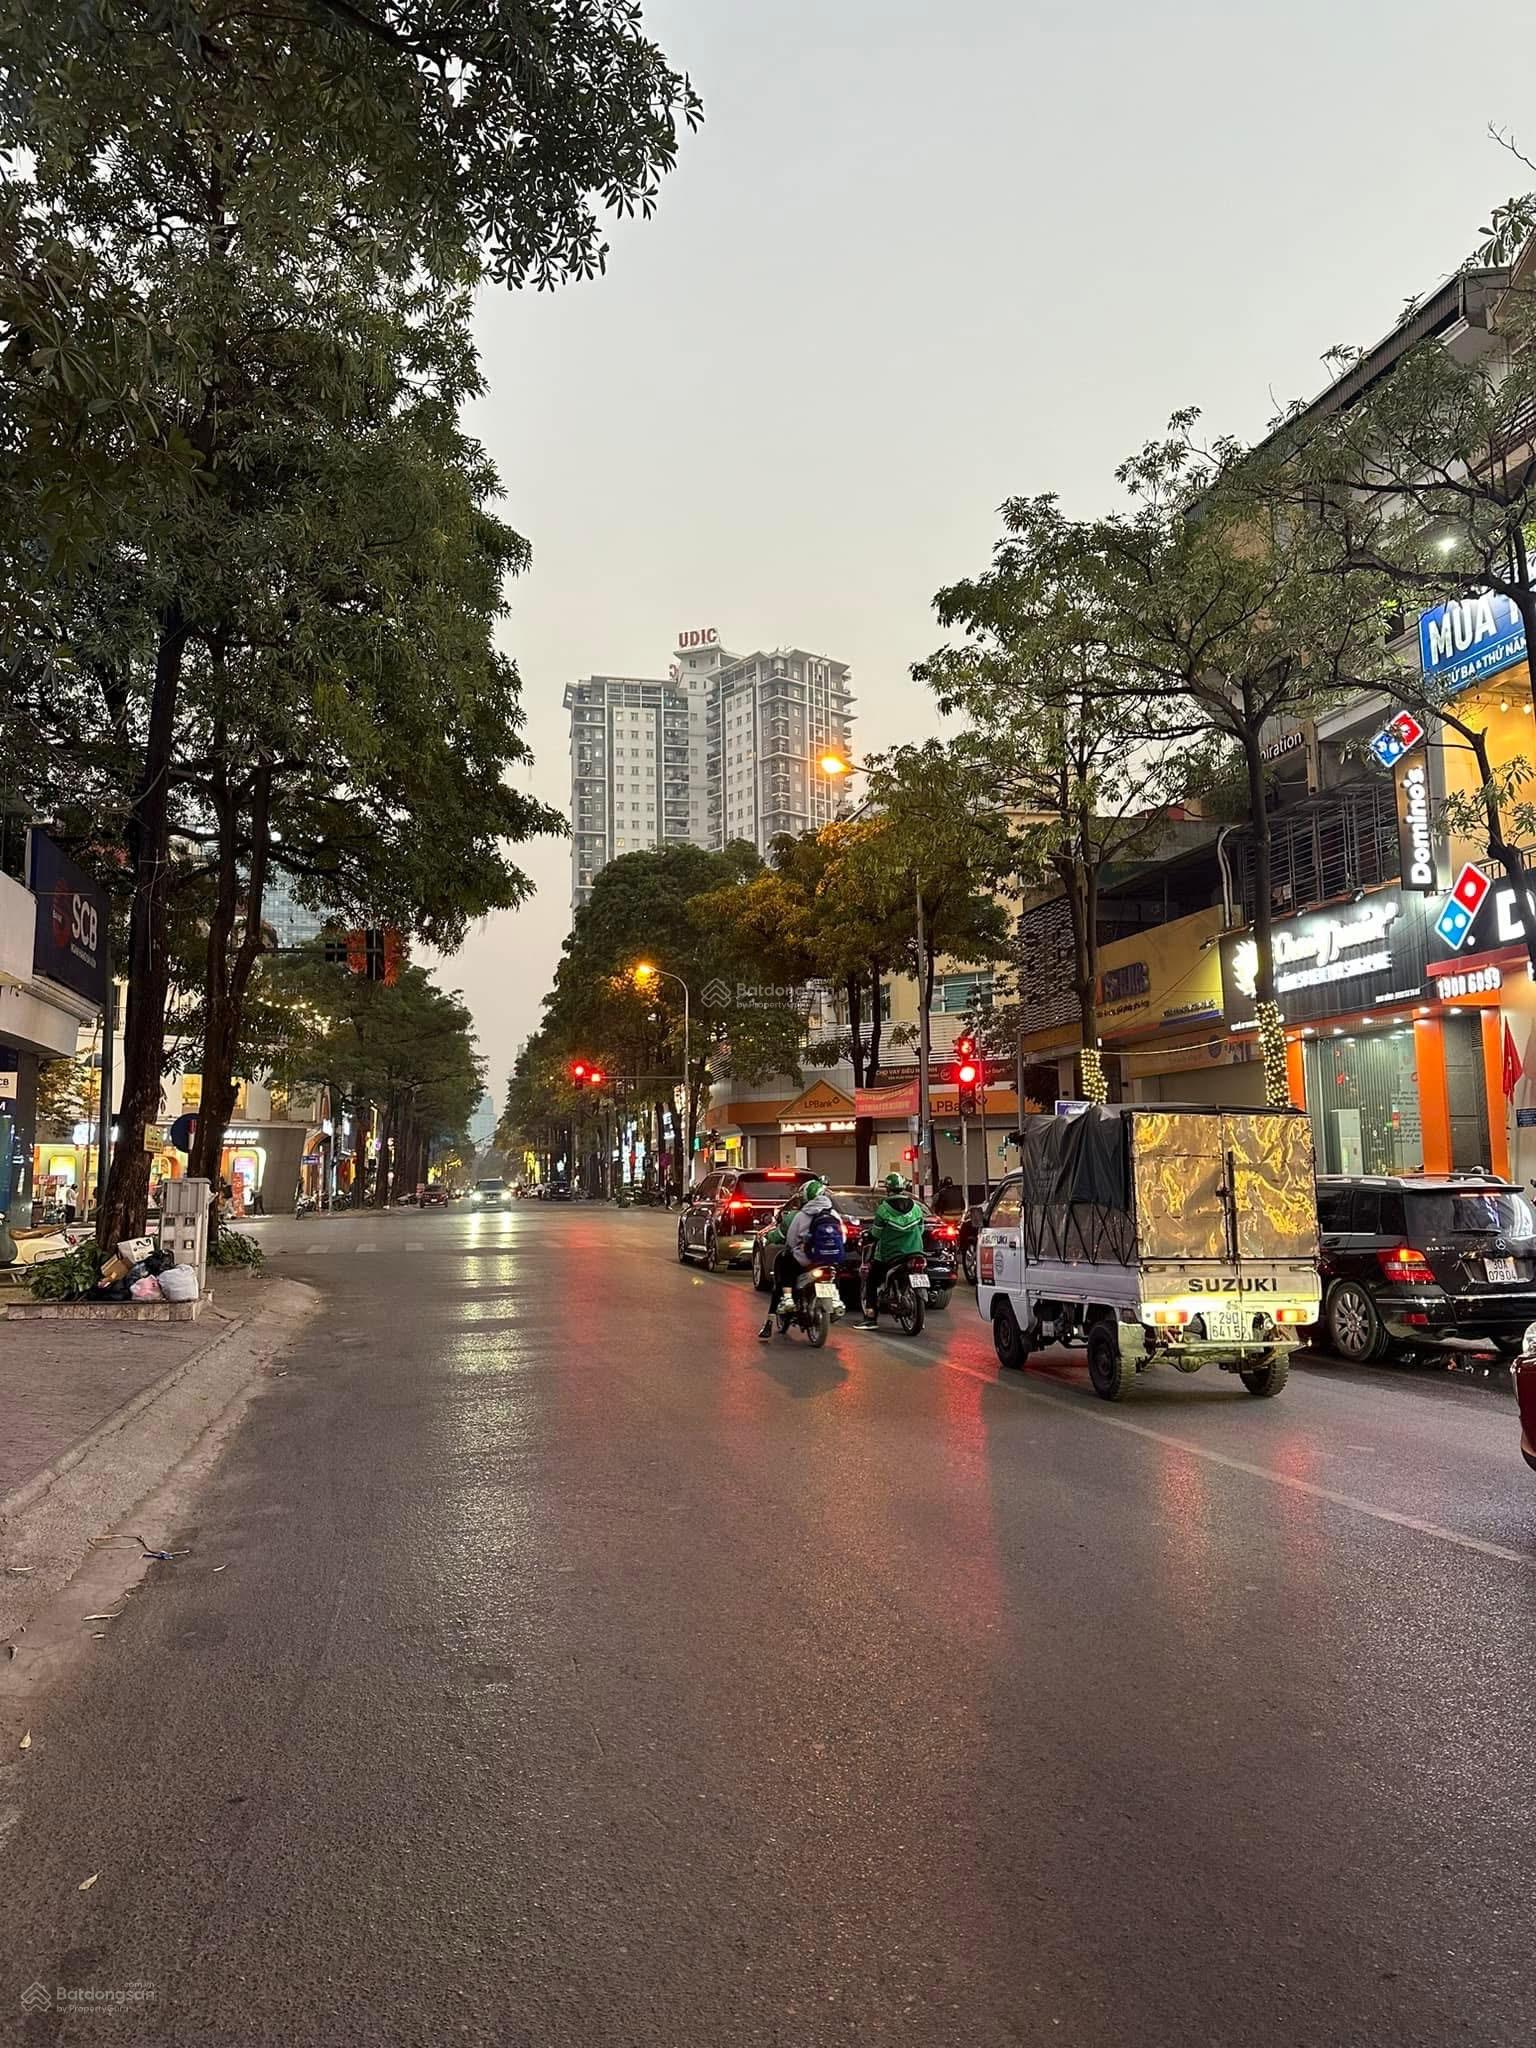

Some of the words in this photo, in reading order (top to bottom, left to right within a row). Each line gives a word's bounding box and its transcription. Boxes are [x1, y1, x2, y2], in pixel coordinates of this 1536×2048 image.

[679, 627, 718, 648] UDIC
[1428, 589, 1498, 666] MUA
[1461, 662, 1477, 679] BA
[71, 894, 98, 951] SCB
[1437, 974, 1467, 1000] 1900
[804, 1100, 832, 1109] LPBank
[1188, 1278, 1278, 1292] SUZUKI
